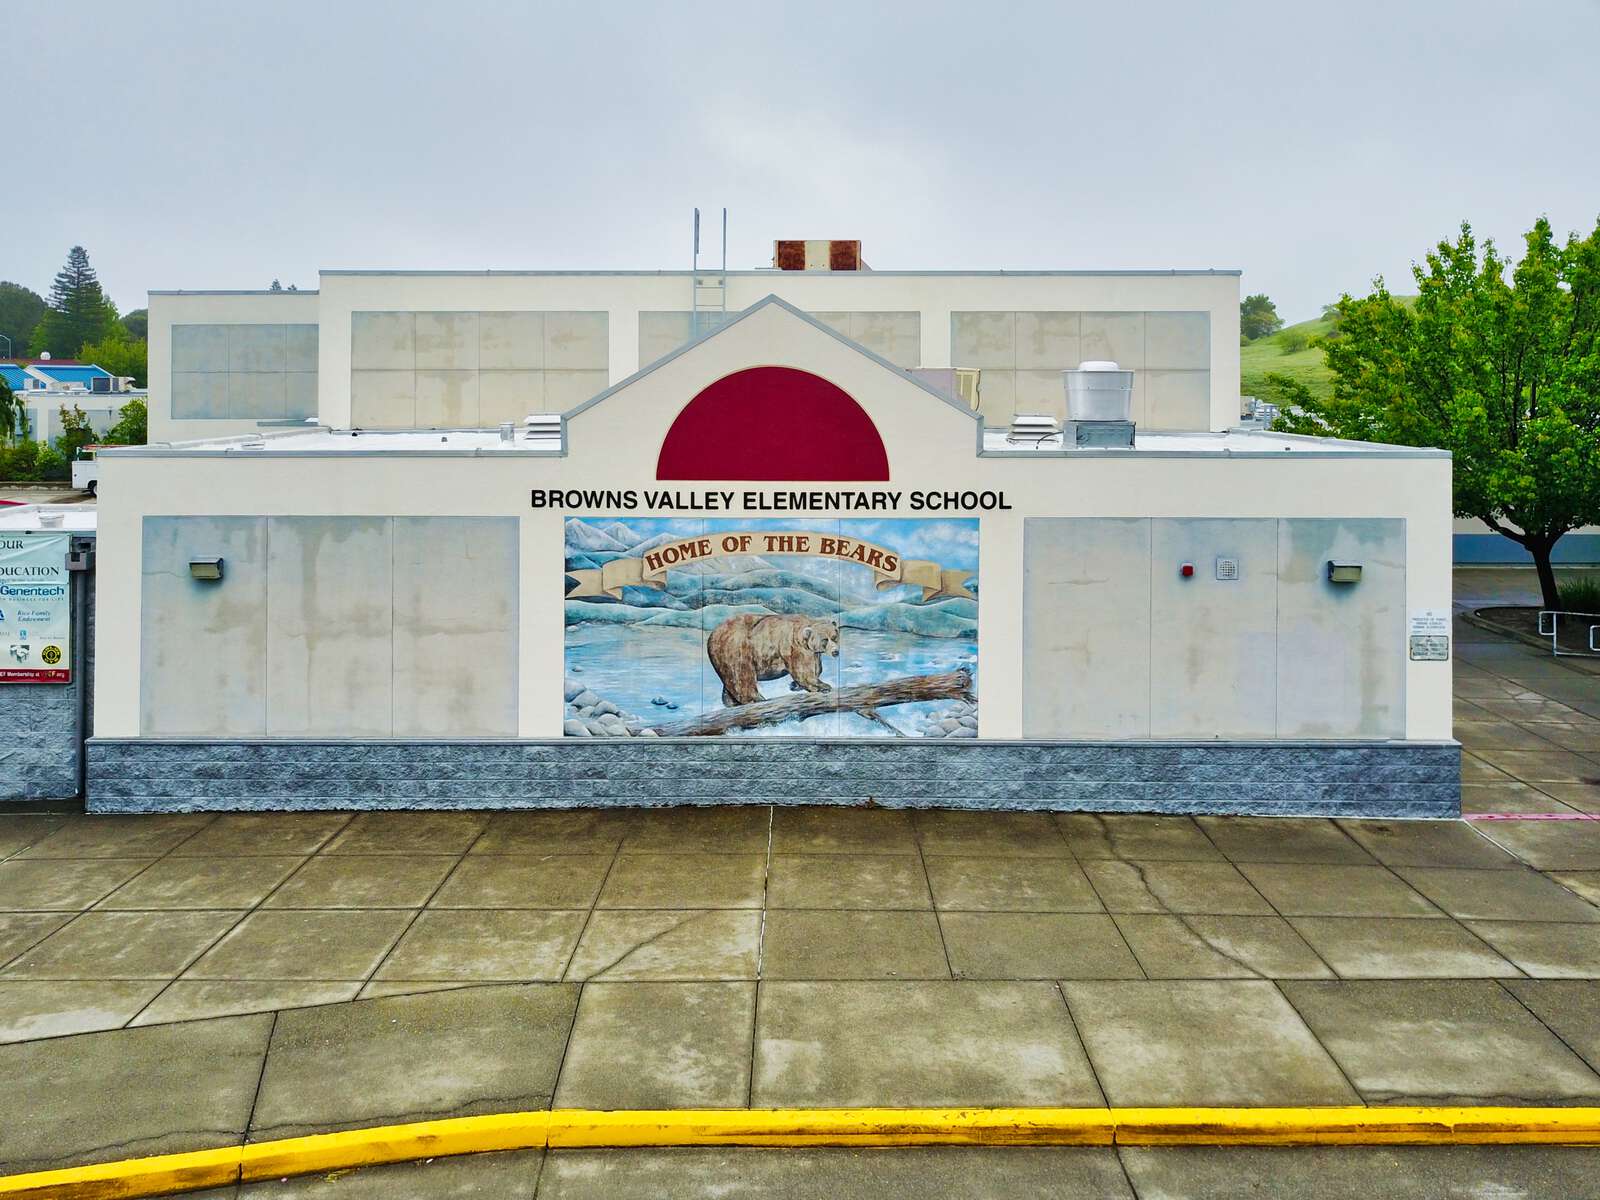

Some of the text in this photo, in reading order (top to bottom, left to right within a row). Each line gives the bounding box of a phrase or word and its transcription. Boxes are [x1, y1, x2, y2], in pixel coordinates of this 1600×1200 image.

[531, 489, 1012, 510] BROWNS VALLEY ELEMENTARY SCHOOL
[645, 535, 899, 572] HOME OF THE BEARS
[0, 585, 65, 596] Genentech
